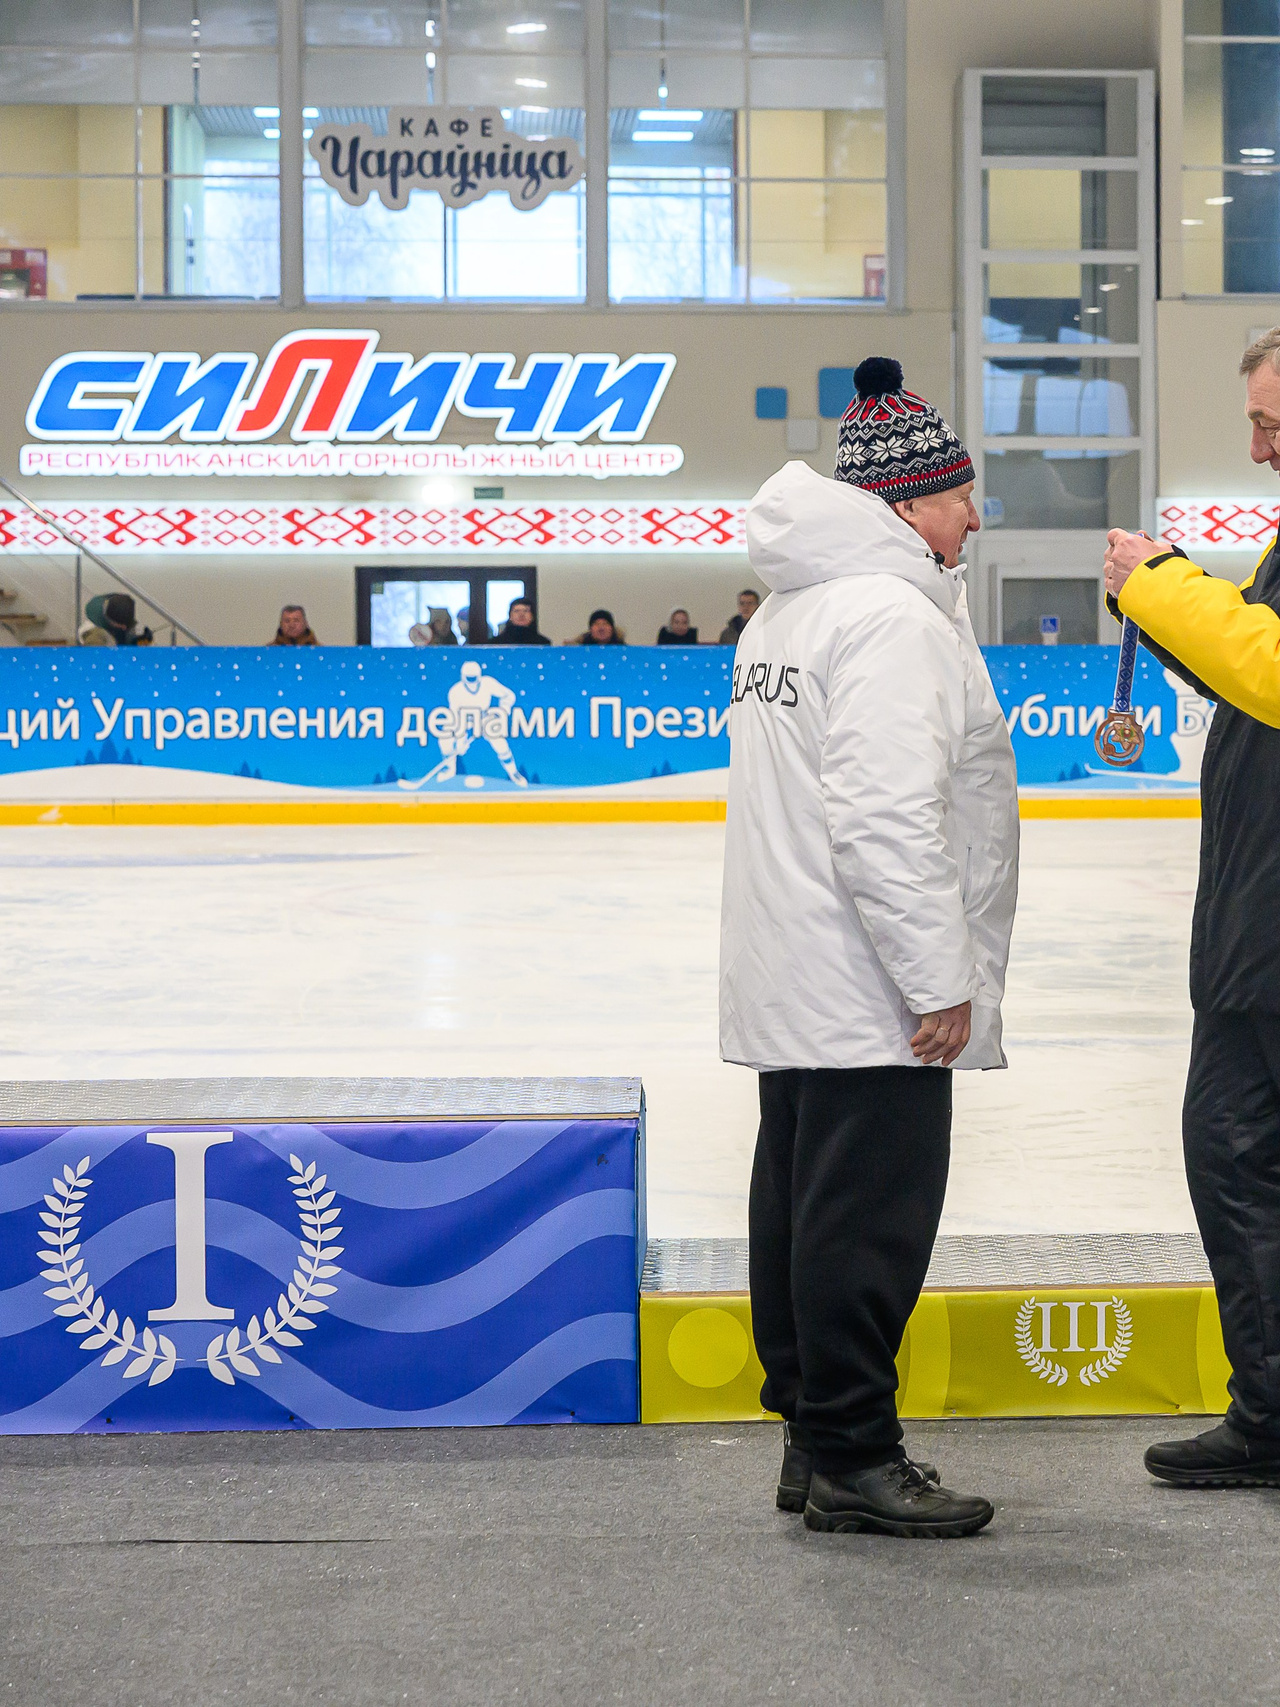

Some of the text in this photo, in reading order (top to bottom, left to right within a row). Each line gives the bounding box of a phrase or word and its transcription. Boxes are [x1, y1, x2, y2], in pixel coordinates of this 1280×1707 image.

[400, 117, 493, 138] КАФЕ
[320, 134, 573, 201] Чараўніца
[27, 449, 676, 470] РЕСПУБЛИКАНСКИЙ ГОРНОЛЫЖНЫЙ ЦЕНТР
[92, 697, 385, 750] Управления
[396, 706, 575, 747] делами
[146, 1131, 235, 1321] I
[1035, 1301, 1113, 1352] III
